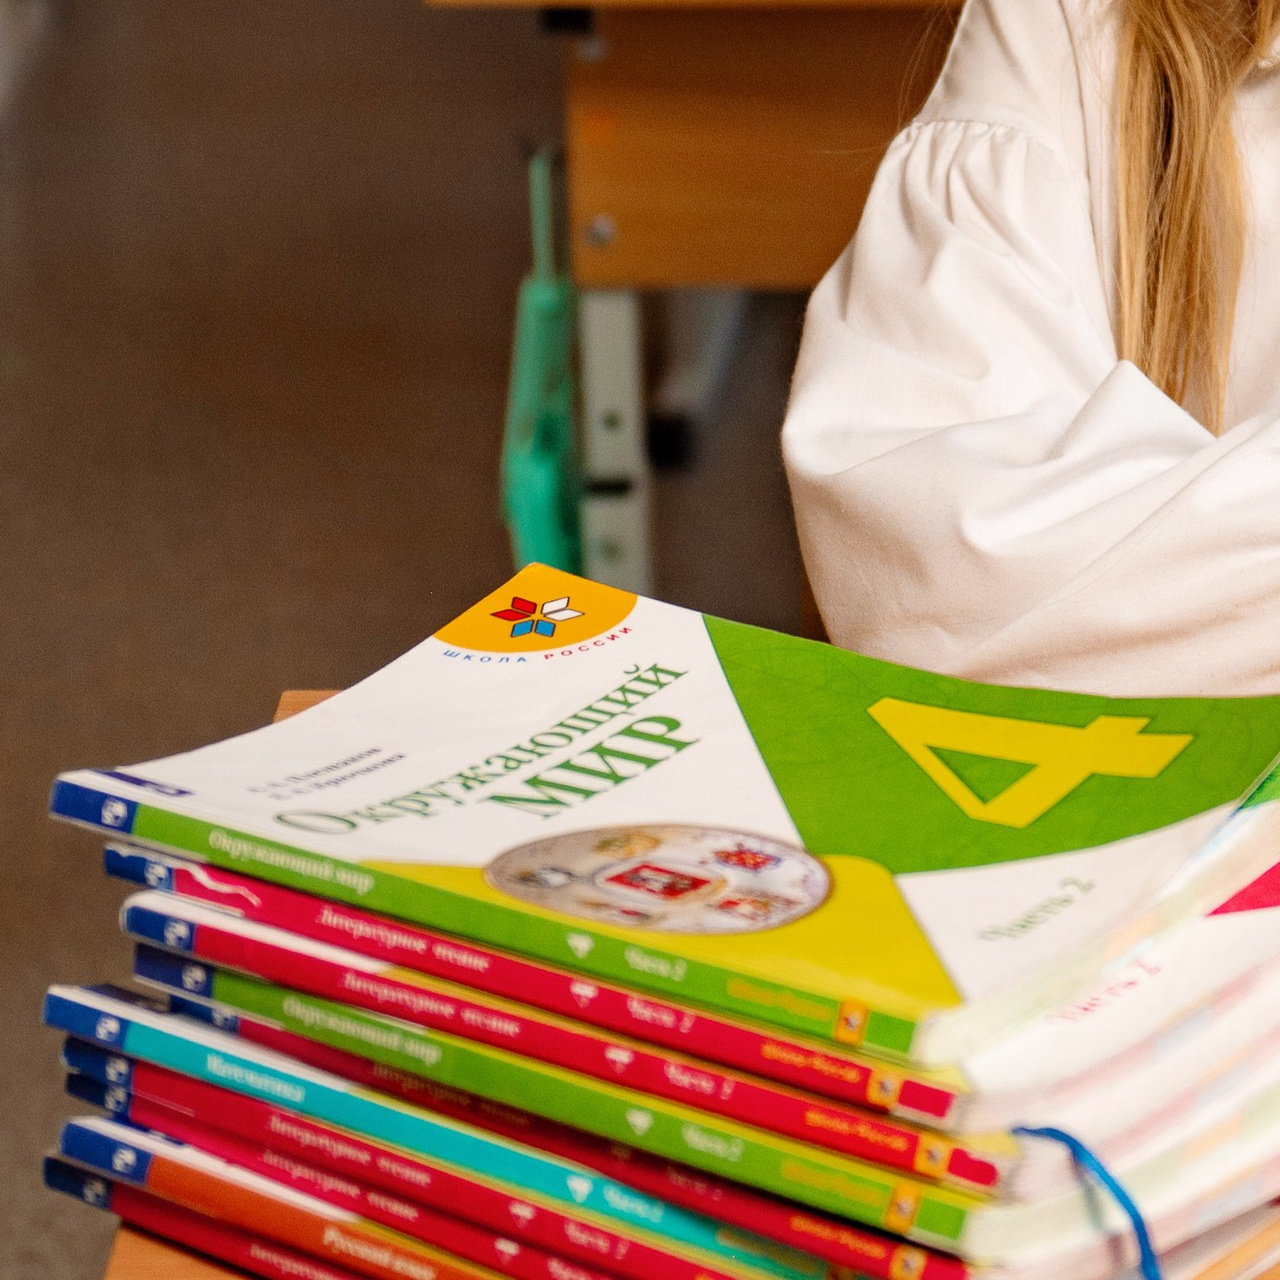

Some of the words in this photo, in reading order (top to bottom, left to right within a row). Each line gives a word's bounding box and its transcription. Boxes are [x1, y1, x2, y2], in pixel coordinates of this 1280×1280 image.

[442, 649, 527, 663] ШКОЛА
[543, 626, 633, 660] РОССИИ
[274, 663, 689, 834] Окружающий
[477, 715, 701, 820] МИР
[866, 696, 1195, 829] 4
